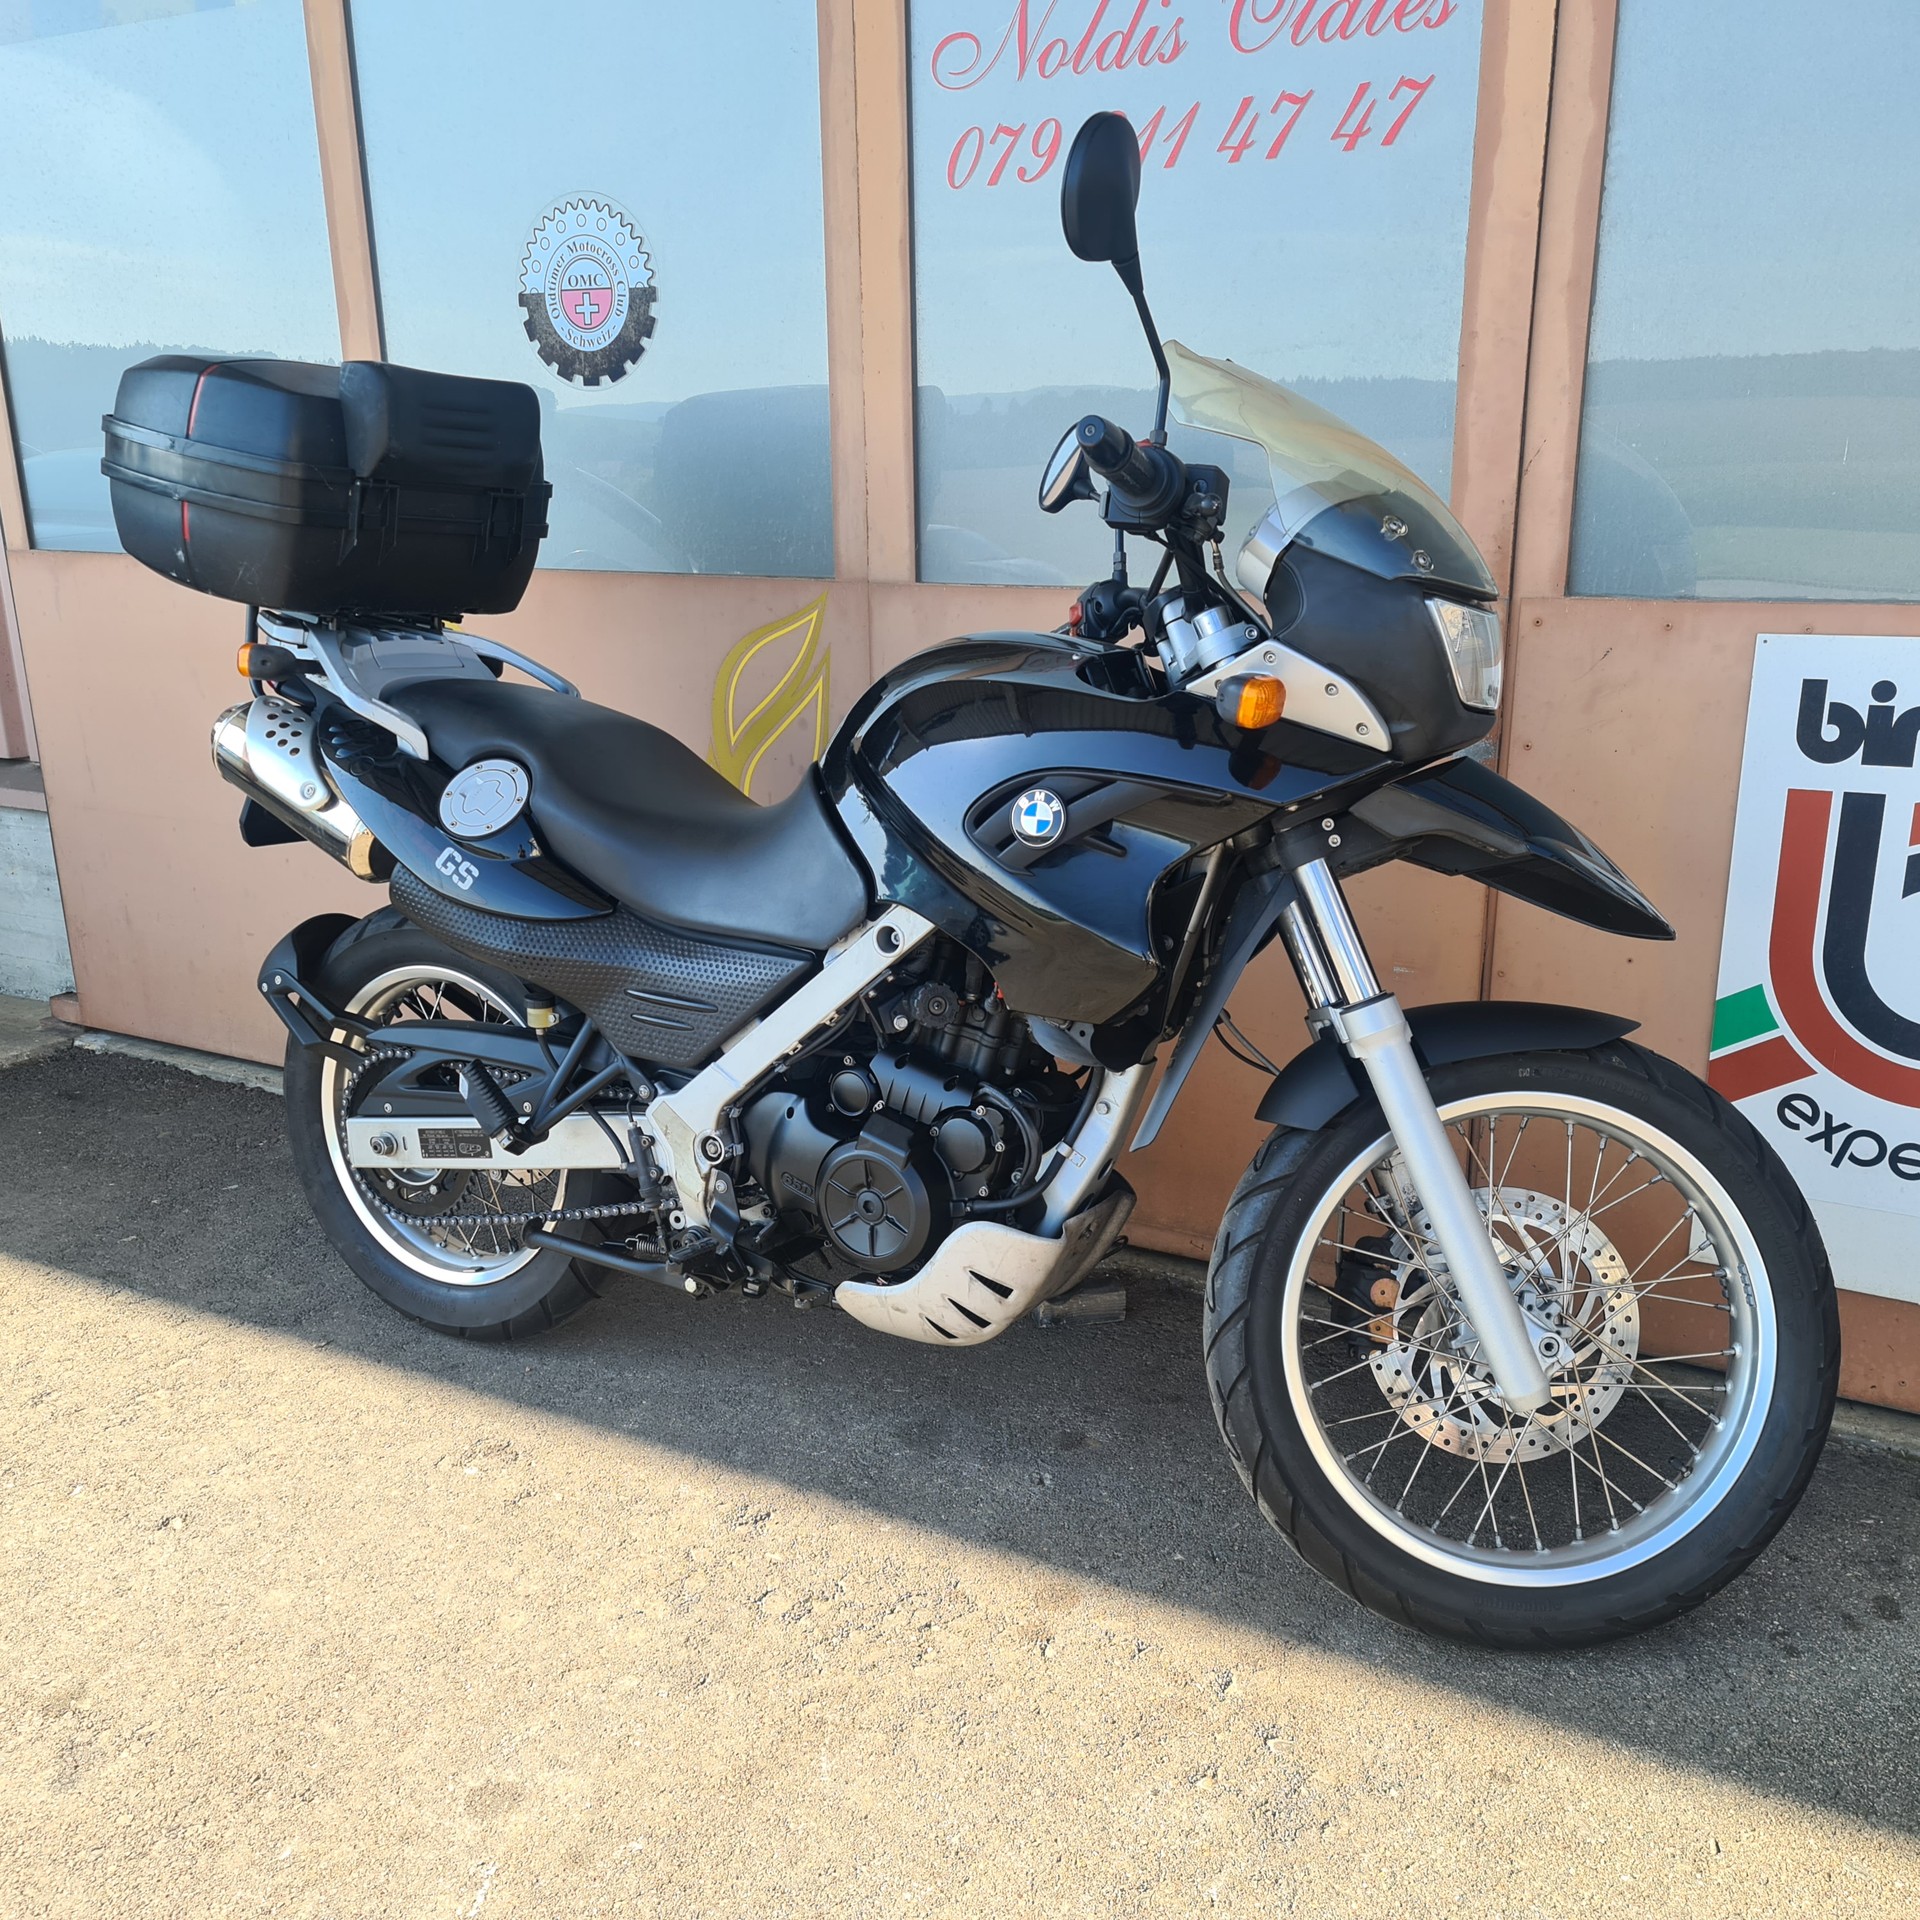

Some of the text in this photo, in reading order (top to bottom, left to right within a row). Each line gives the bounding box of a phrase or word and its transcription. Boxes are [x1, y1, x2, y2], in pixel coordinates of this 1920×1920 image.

[931, 0, 1189, 90] Noldis
[946, 118, 1063, 190] 079
[1216, 88, 1315, 164] 47
[1330, 74, 1436, 152] 47
[547, 241, 627, 320] Oldtimer Motocross Club
[568, 273, 604, 288] OMC
[564, 328, 613, 348] Schweiz
[1018, 791, 1061, 812] BMW
[435, 846, 480, 891] GS
[783, 1173, 815, 1197] 650
